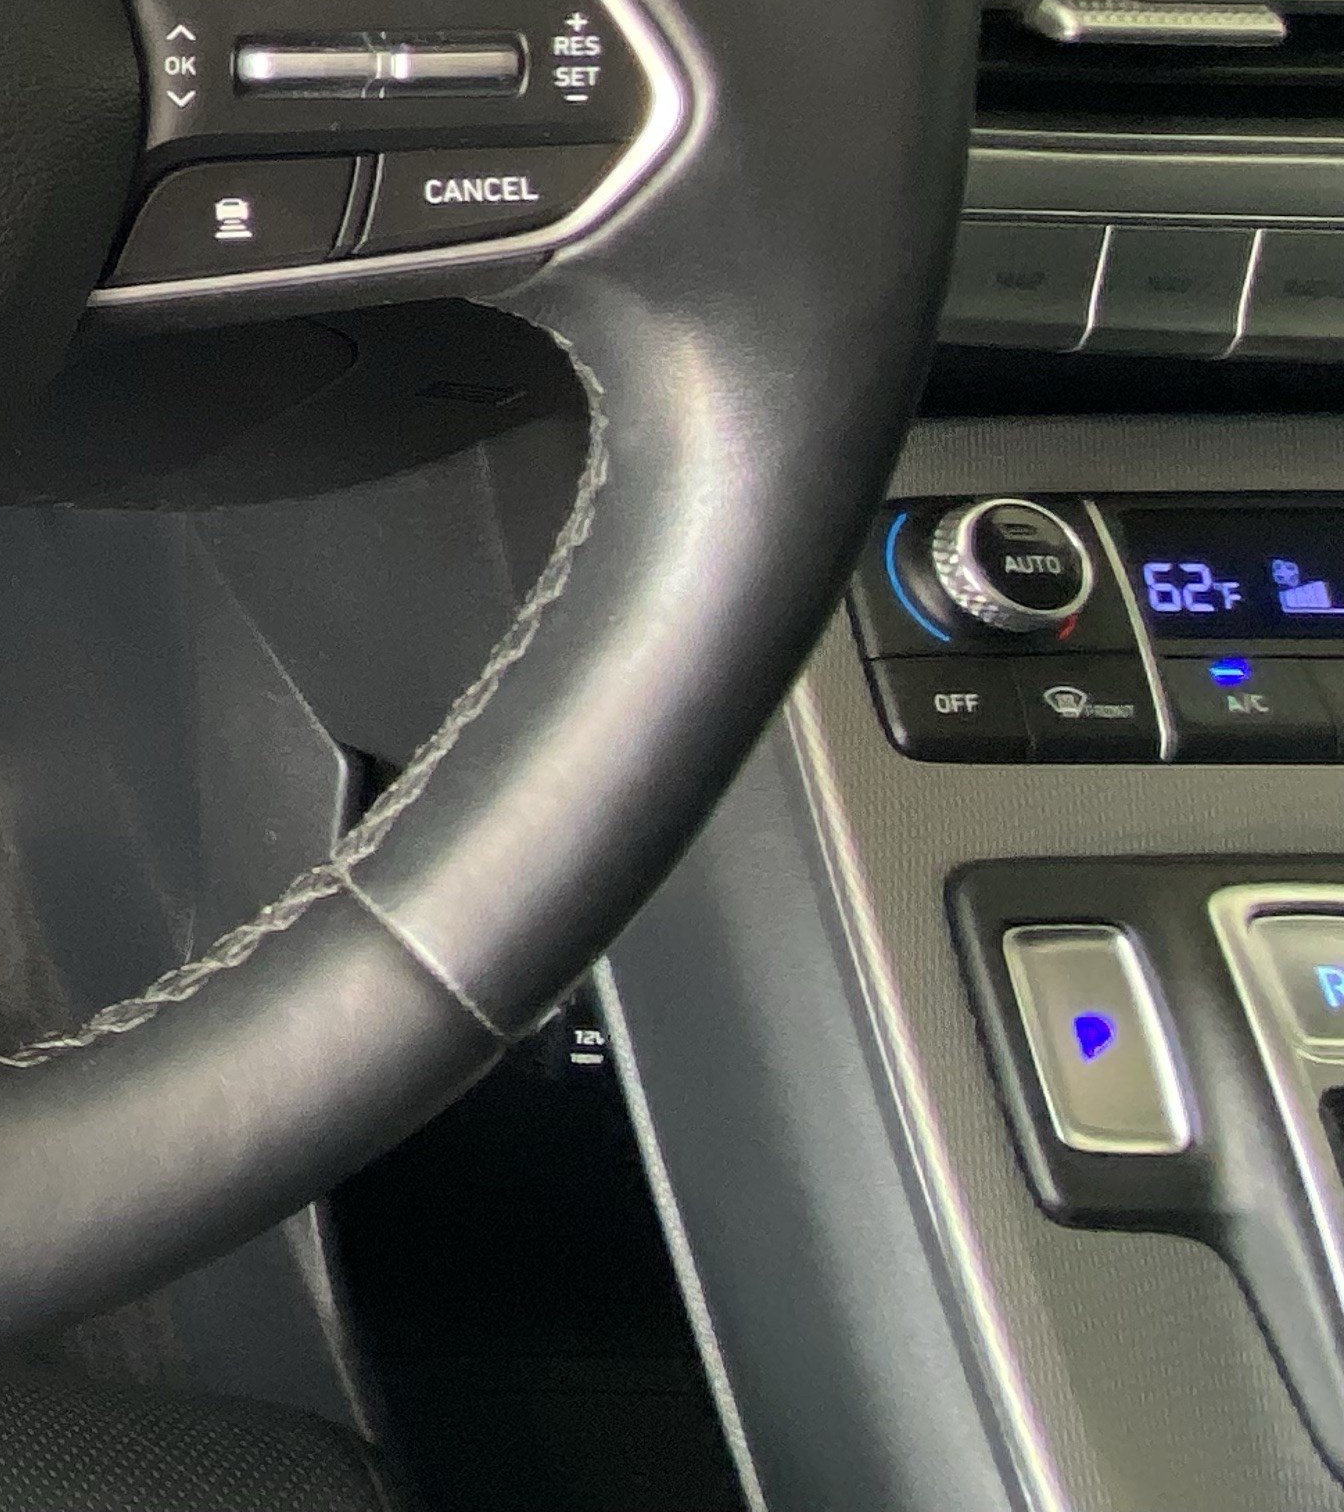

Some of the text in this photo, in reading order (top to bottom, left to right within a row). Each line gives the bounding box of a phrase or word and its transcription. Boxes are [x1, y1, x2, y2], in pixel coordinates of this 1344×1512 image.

[554, 36, 600, 57] RES
[164, 56, 197, 76] OK
[554, 67, 600, 88] SET
[424, 177, 539, 204] CANCEL
[1004, 555, 1062, 575] AUTO
[934, 693, 979, 714] OFF
